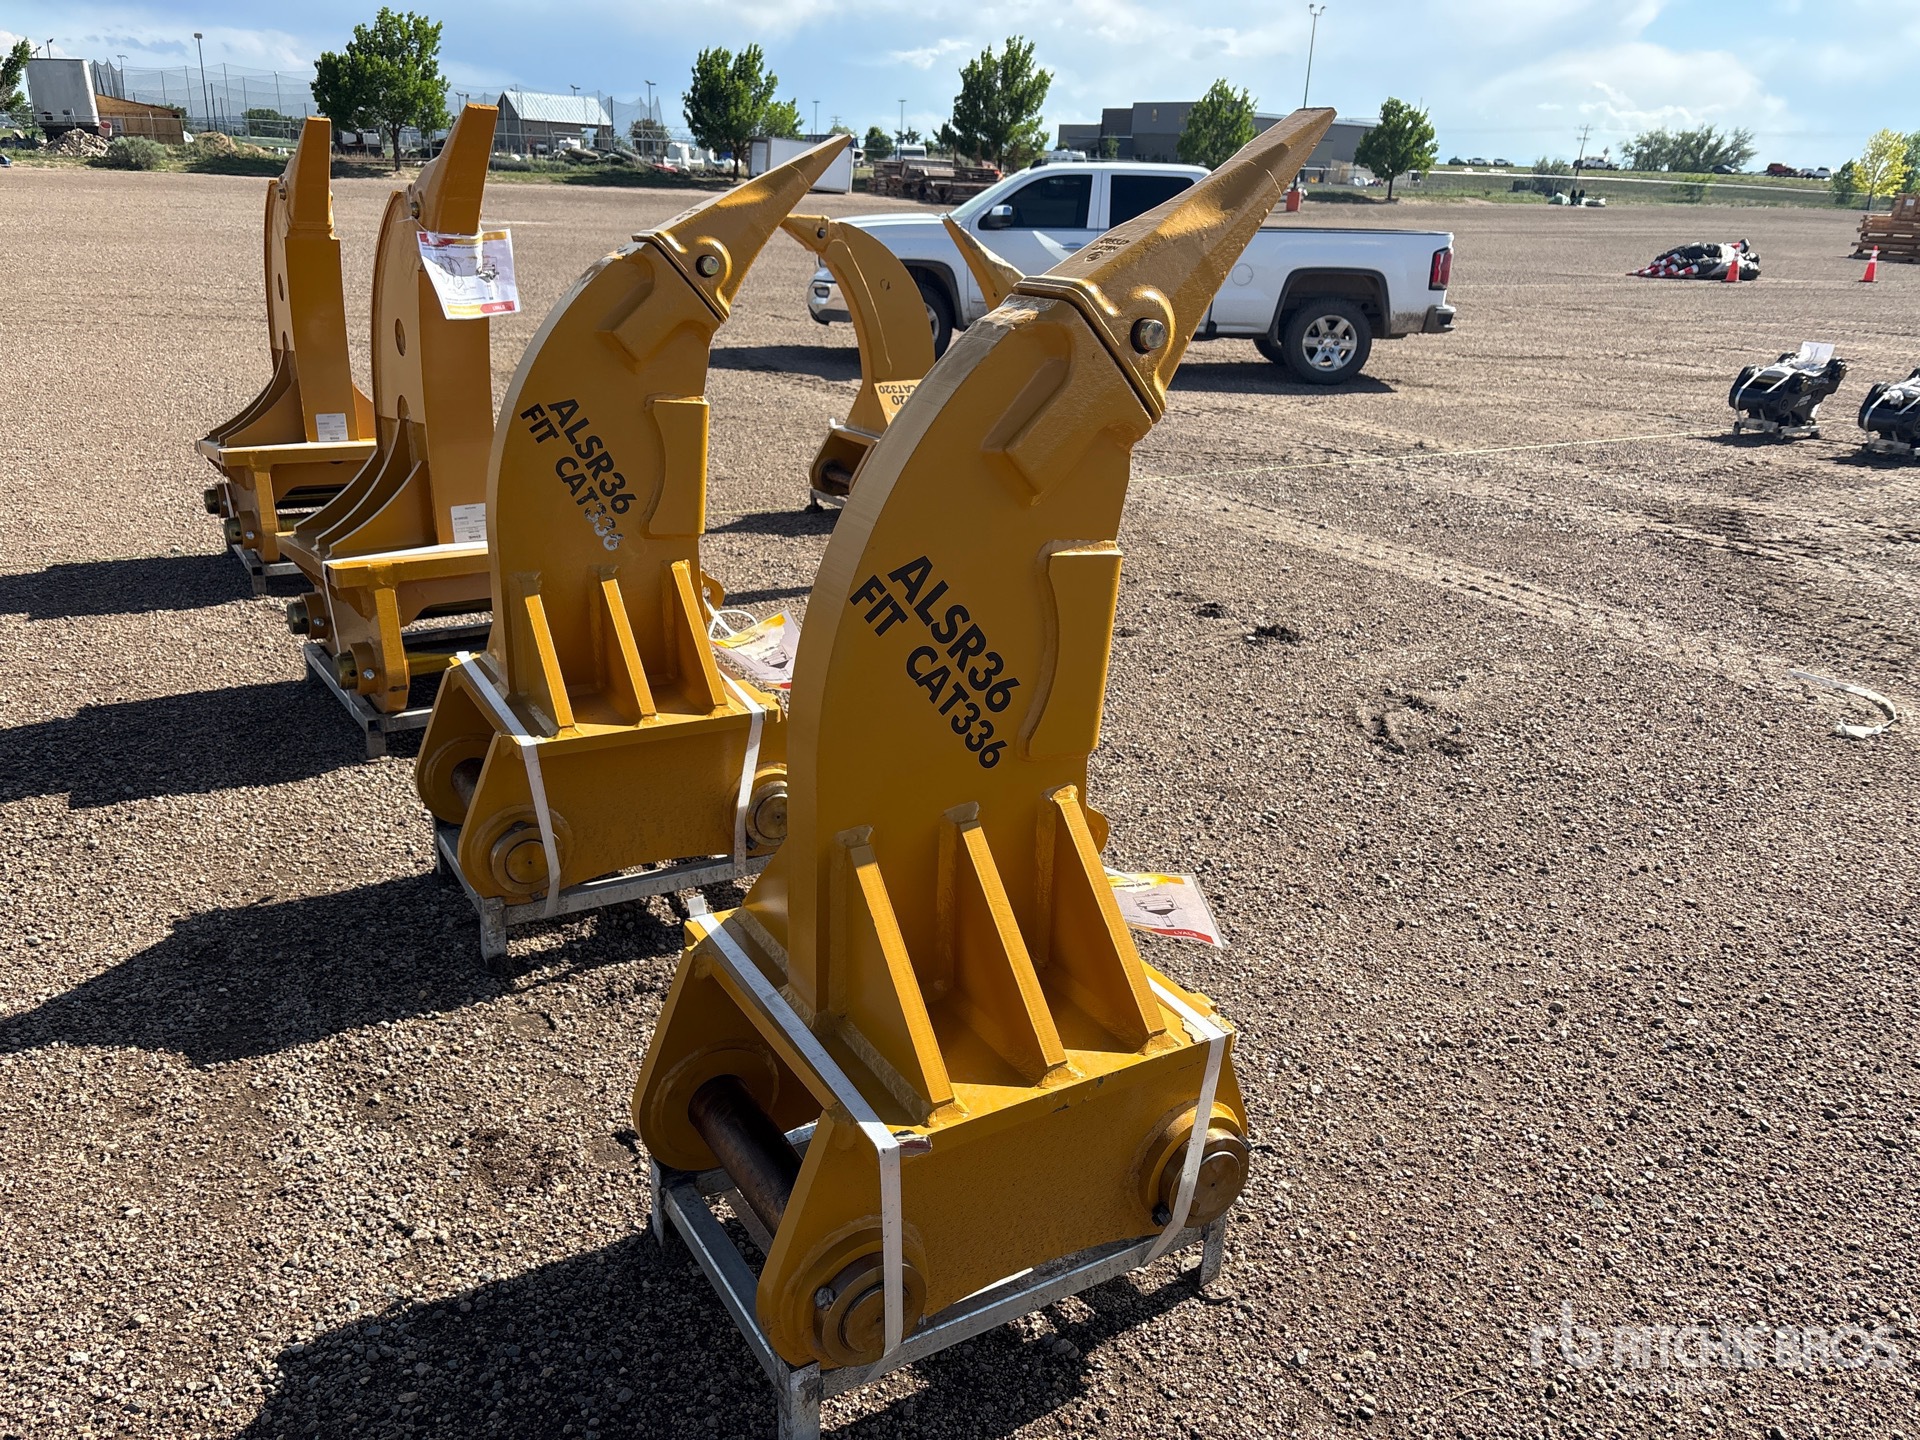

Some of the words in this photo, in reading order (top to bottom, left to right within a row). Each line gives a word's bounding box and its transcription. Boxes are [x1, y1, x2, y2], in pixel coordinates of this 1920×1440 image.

[520, 403, 560, 444] FIT
[555, 456, 625, 551] CAT336
[547, 398, 637, 515] ALSR36
[849, 574, 909, 637] FIT
[906, 645, 1008, 769] CAT336
[887, 555, 1021, 713] ALSR36
